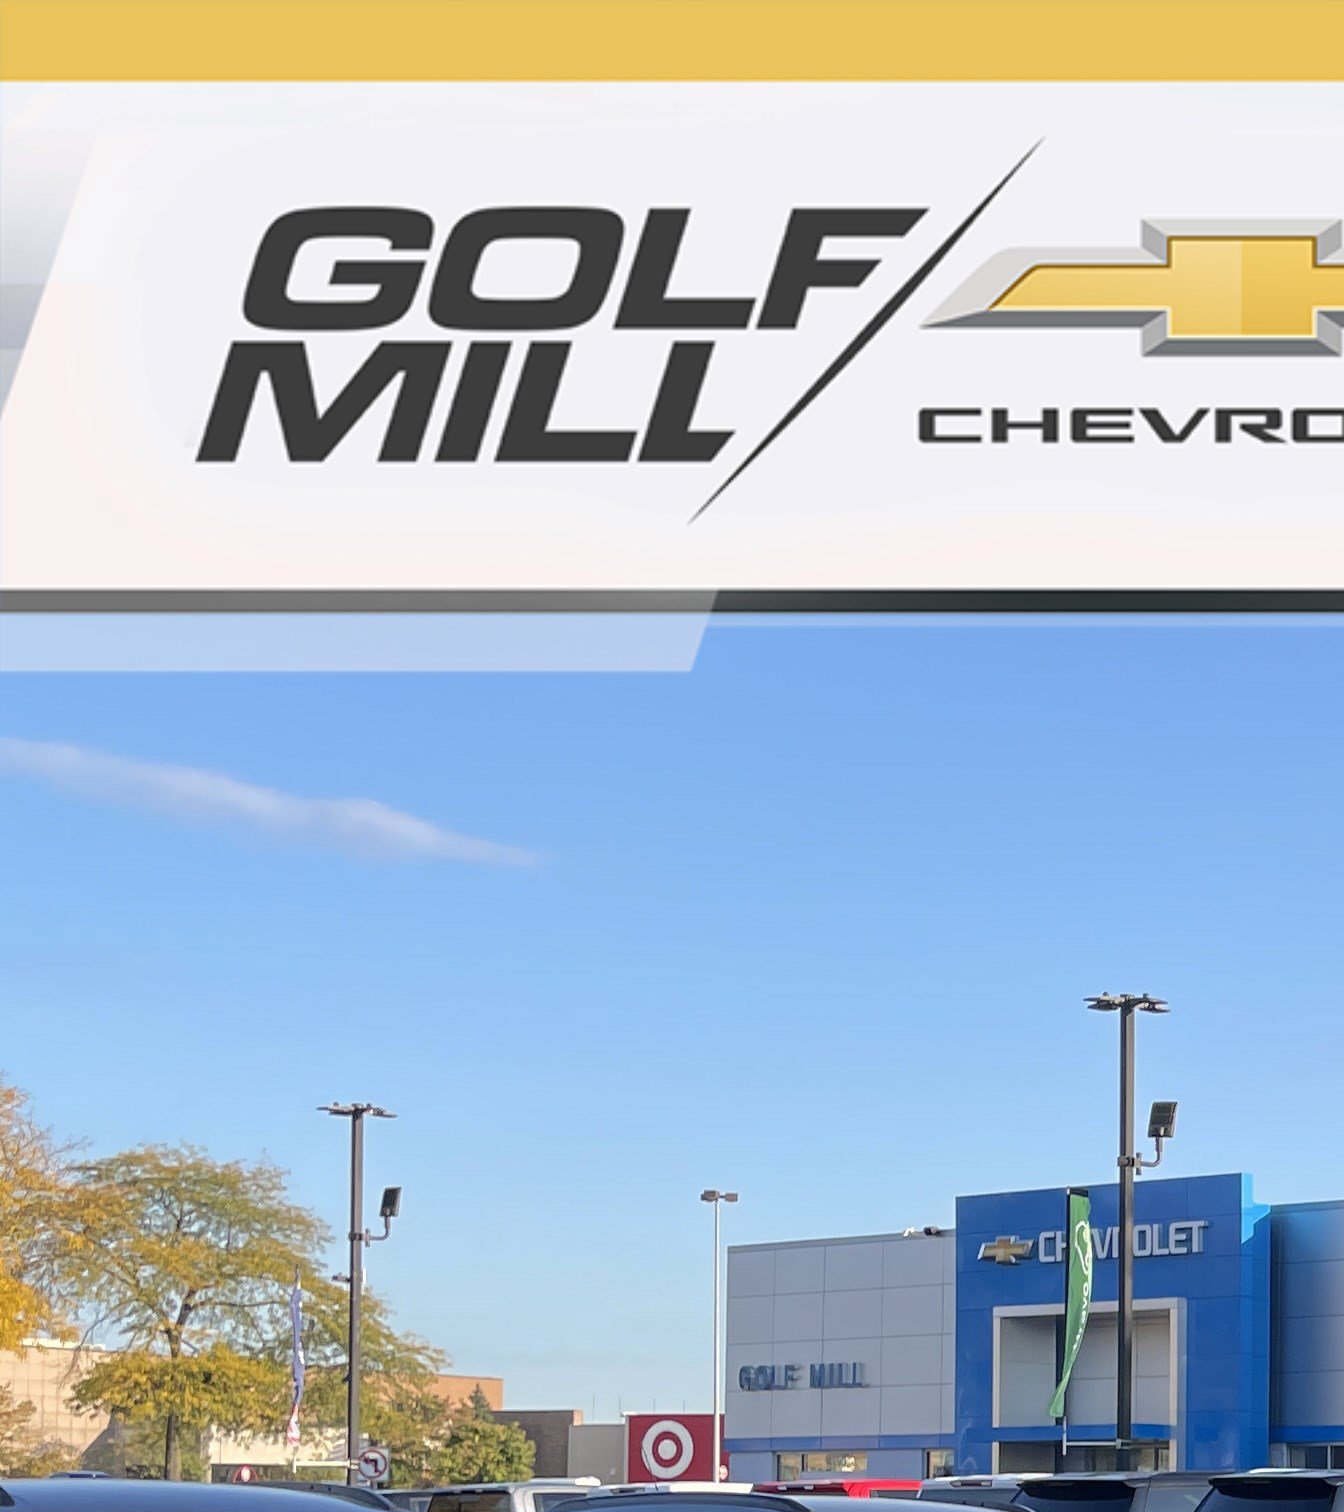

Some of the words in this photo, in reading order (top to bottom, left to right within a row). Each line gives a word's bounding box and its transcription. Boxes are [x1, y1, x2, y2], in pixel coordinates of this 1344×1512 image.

[1038, 1220, 1209, 1263] CHVOLET
[738, 1364, 800, 1391] GOLF
[809, 1362, 865, 1389] MILL
